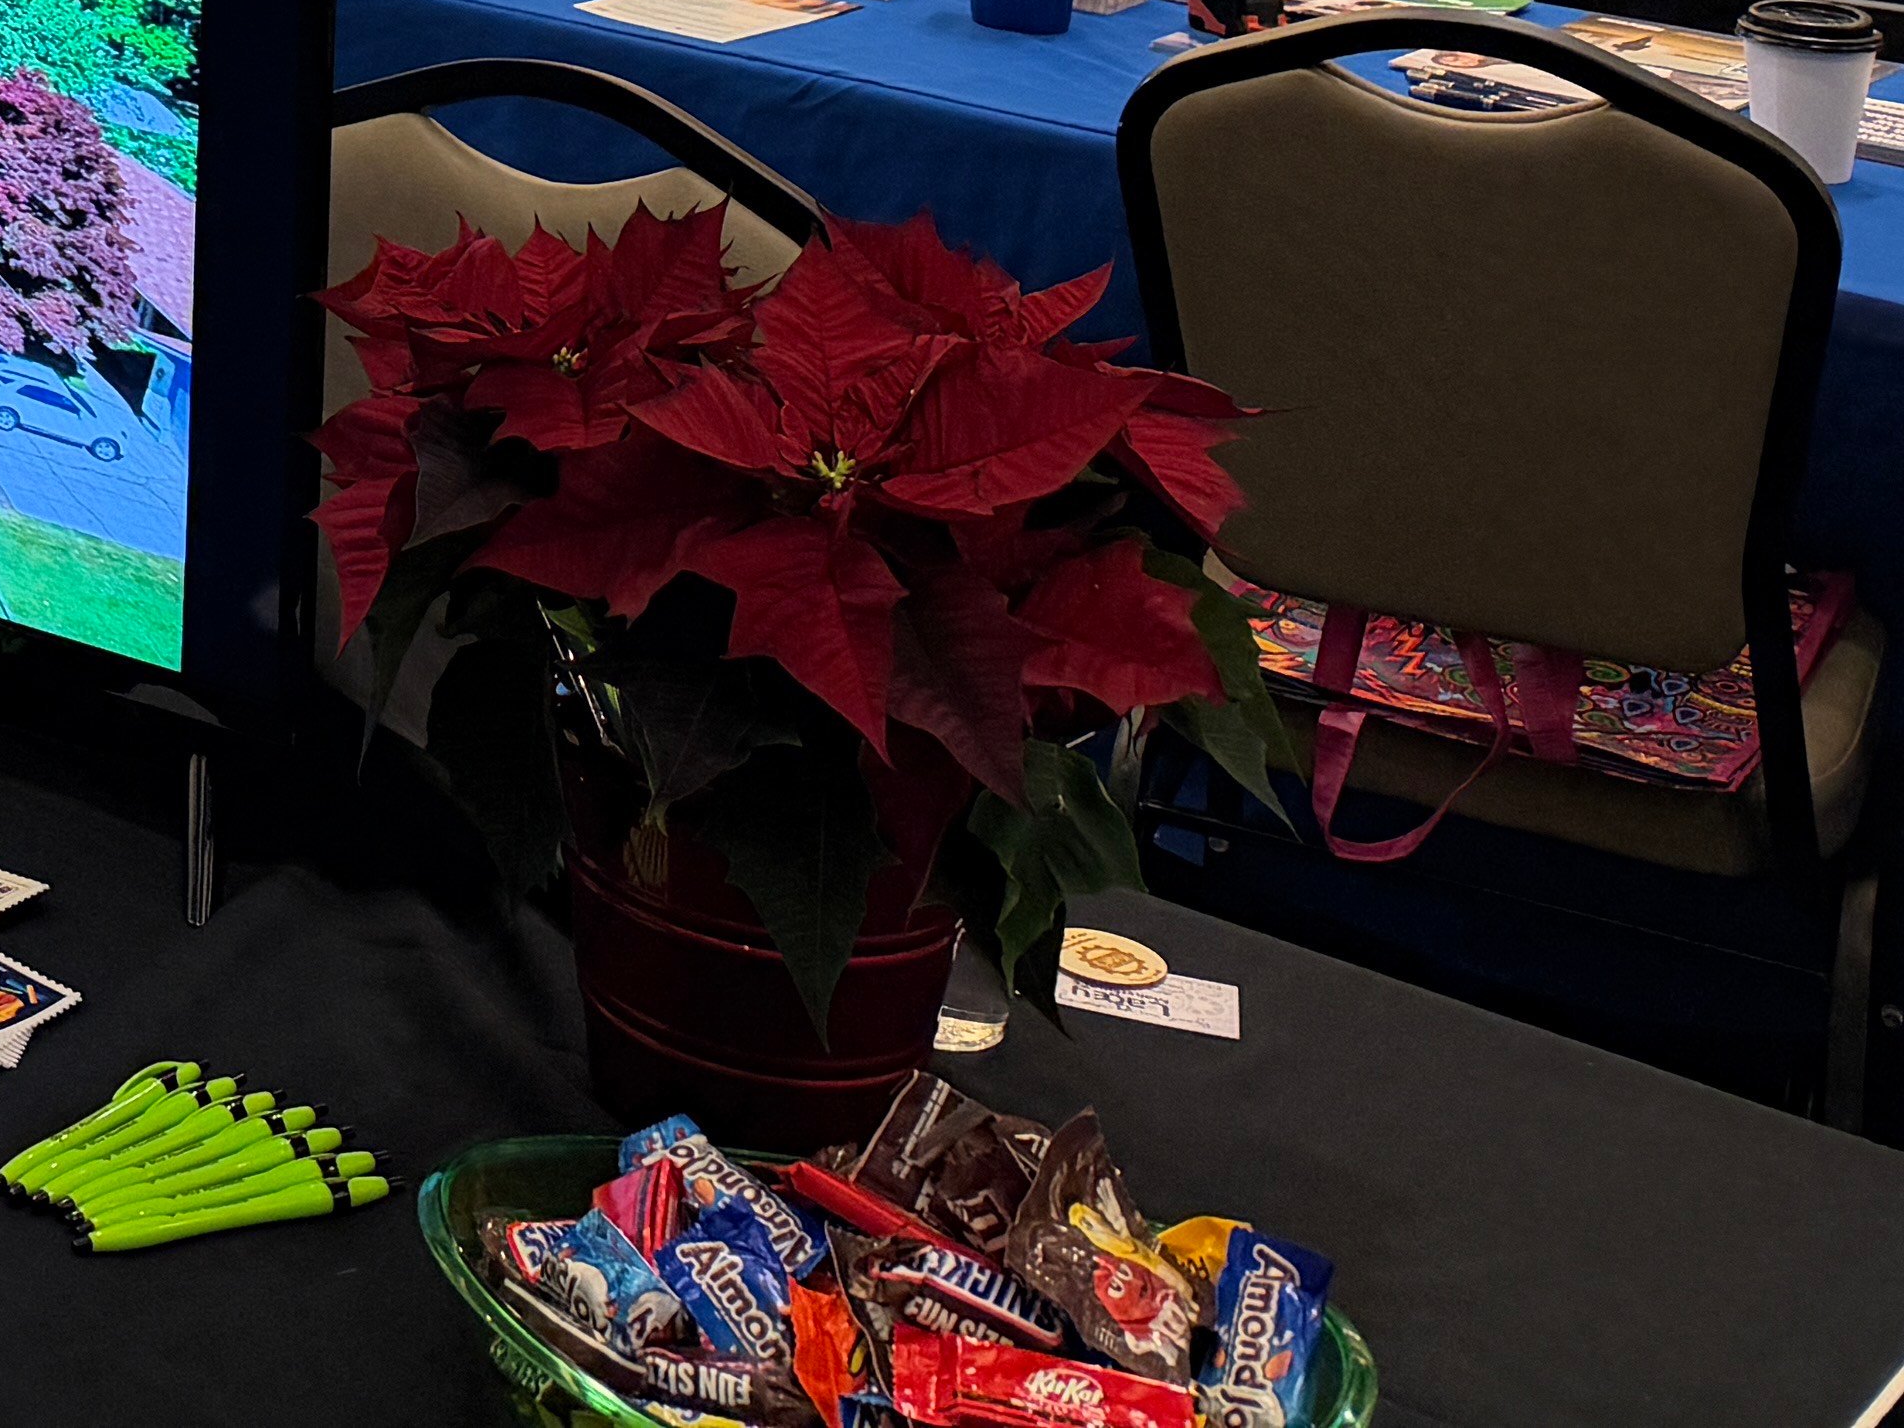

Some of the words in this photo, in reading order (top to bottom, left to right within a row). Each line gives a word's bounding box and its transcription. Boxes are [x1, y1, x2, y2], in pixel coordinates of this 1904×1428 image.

[675, 1240, 792, 1359] Almo
[903, 1295, 958, 1334] FUN
[1232, 1244, 1303, 1393] Amond
[700, 1364, 754, 1406] FUN
